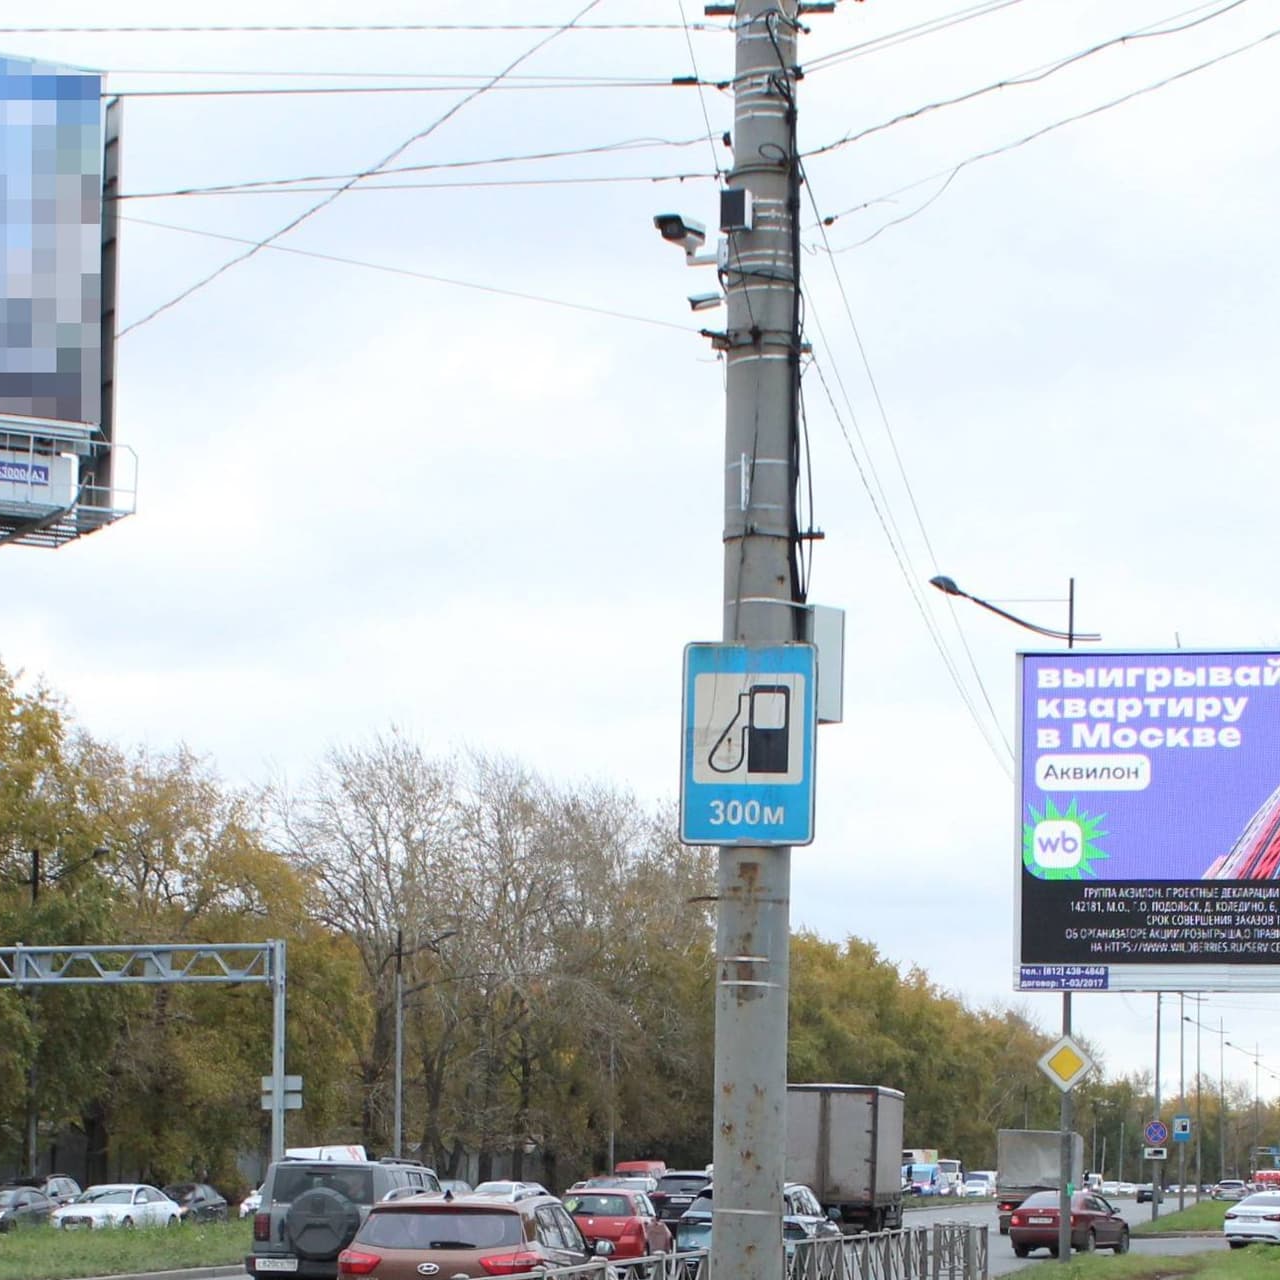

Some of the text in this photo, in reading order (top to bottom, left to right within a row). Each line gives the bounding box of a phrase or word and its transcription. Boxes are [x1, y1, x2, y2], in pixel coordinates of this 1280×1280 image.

[1037, 696, 1248, 723] квартиру
[1037, 723, 1241, 748] в Москве
[1044, 764, 1140, 780] Аквилон
[1038, 829, 1079, 854] wb
[1043, 967, 1064, 976] (812)
